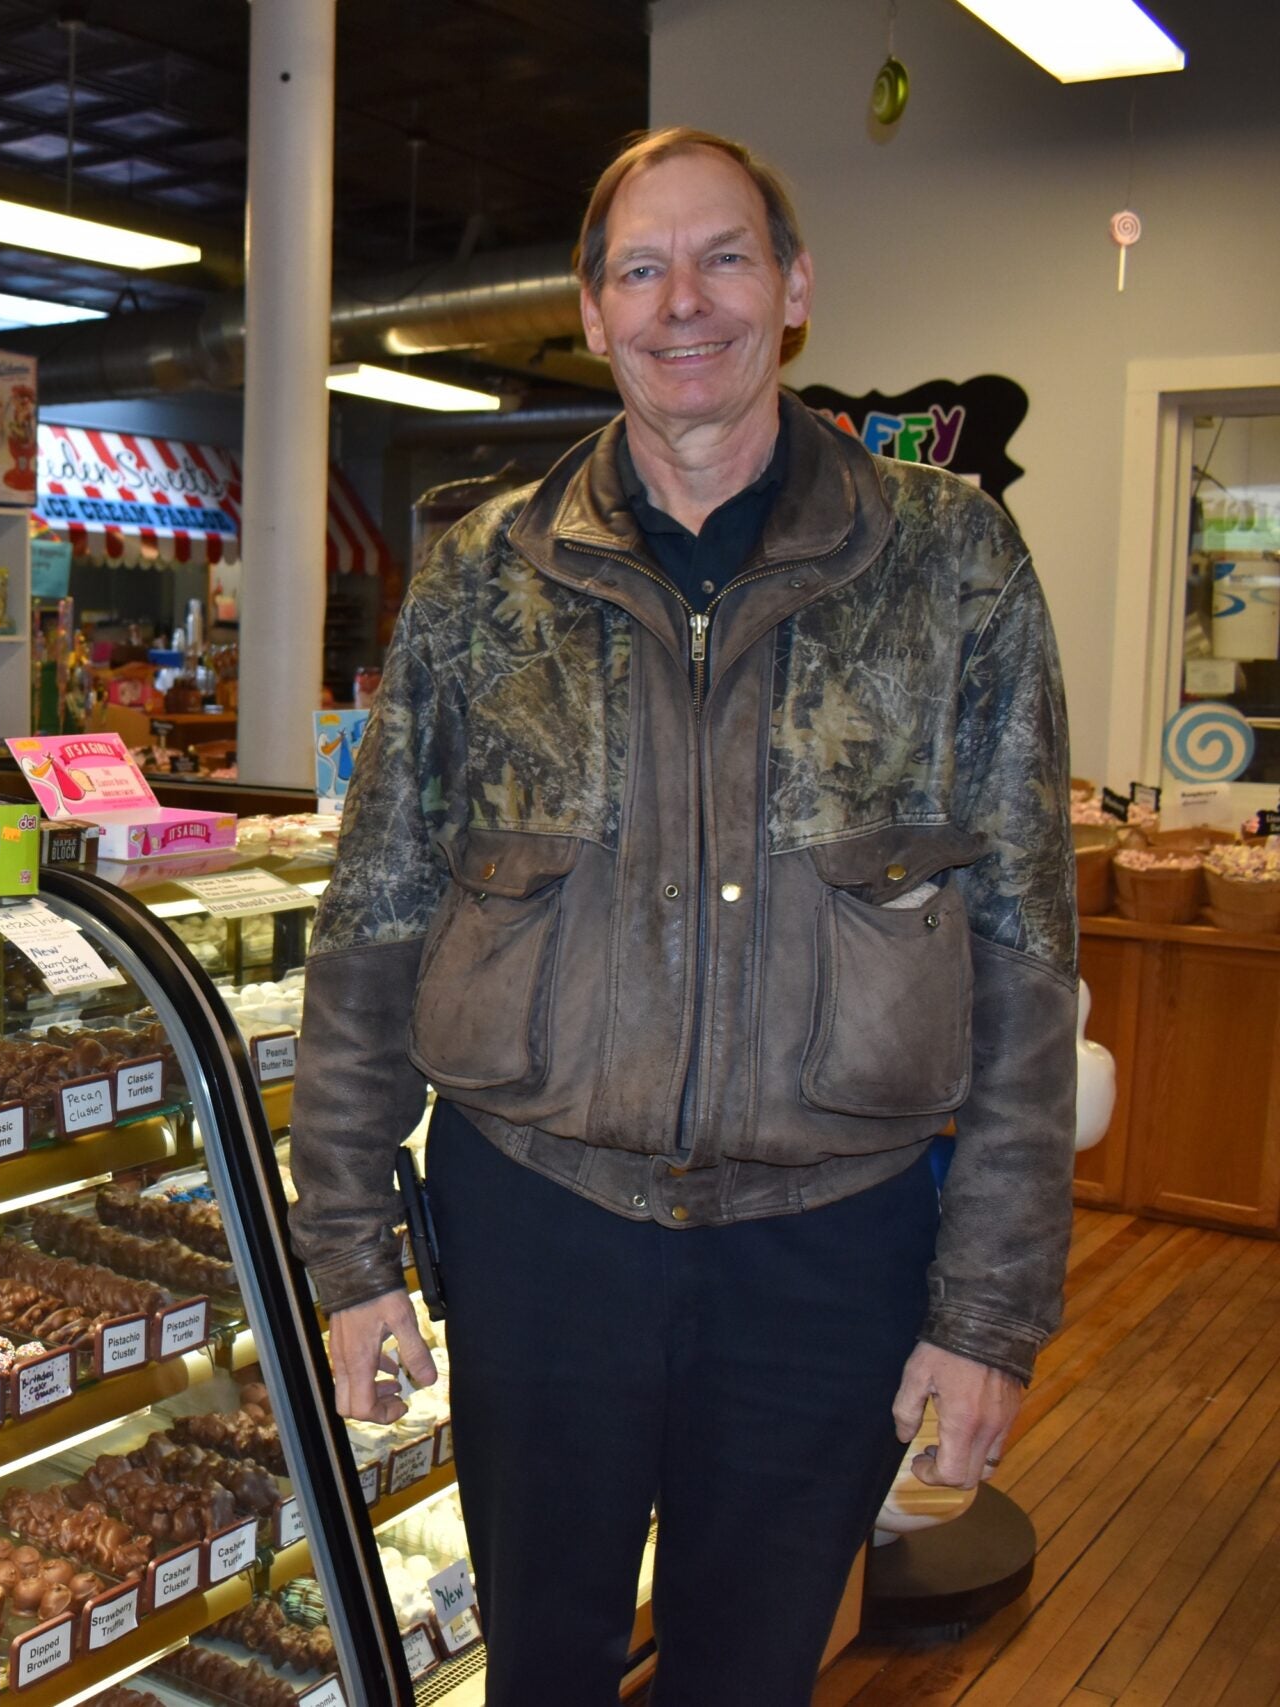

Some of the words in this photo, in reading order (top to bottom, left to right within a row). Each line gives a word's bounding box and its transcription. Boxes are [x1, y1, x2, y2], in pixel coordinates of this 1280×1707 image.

[116, 451, 228, 497] Sweets
[44, 498, 77, 518] ICE
[79, 500, 152, 524] CREAM
[65, 743, 80, 758] IT'S
[81, 742, 89, 754] A
[90, 741, 113, 755] GIRL!
[19, 814, 37, 831] dci
[170, 825, 182, 840] IT'S
[183, 824, 188, 836] A
[189, 824, 207, 837] GIRL!
[51, 846, 76, 860] BLOCK
[266, 1047, 288, 1058] Peanut
[261, 1060, 282, 1071] Butter
[282, 1059, 293, 1068] Ritz
[127, 1071, 154, 1085] Classic
[128, 1085, 153, 1098] Turtles
[166, 1314, 200, 1334] Pistachio
[108, 1332, 140, 1349] Pistachio
[173, 1328, 194, 1342] Turtle
[111, 1345, 137, 1360] Cluster
[218, 1537, 246, 1558] Cashew
[222, 1551, 242, 1569] Turtle
[162, 1563, 191, 1583] Cashew
[163, 1577, 190, 1595] Cluster
[91, 1601, 132, 1627] Strawberry
[102, 1616, 124, 1637] Truffle
[30, 1636, 60, 1659] Dipped
[26, 1649, 61, 1673] Brownie
